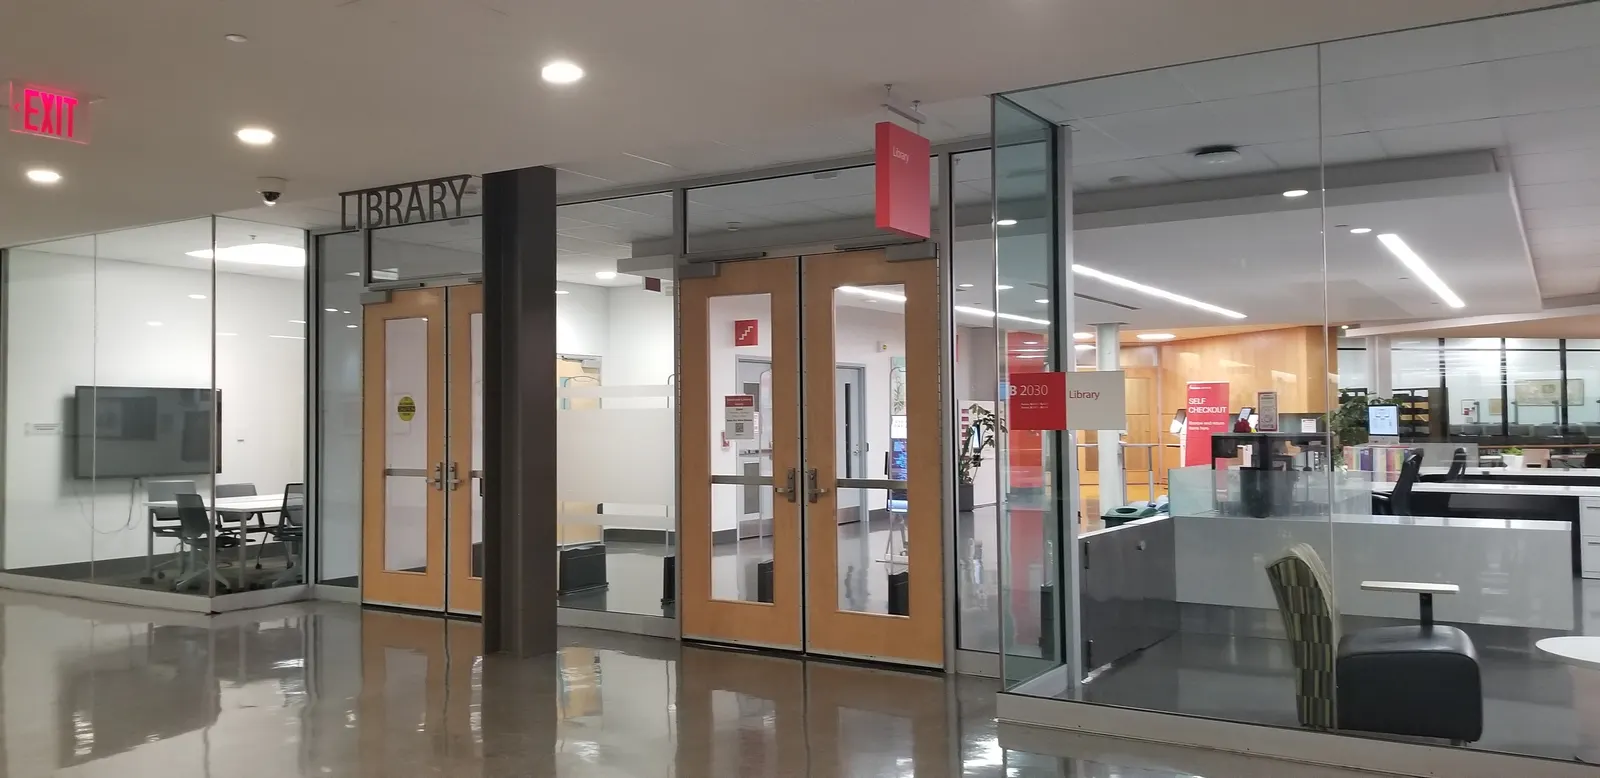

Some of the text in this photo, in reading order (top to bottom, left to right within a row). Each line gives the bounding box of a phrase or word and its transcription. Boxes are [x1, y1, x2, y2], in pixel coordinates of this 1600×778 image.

[24, 88, 78, 138] EXIT
[892, 145, 909, 165] Library
[340, 175, 471, 231] LIBRARY
[1020, 384, 1049, 396] 2030
[1069, 390, 1100, 401] Library
[1188, 397, 1207, 405] SELF
[1188, 406, 1227, 414] CHECKOUT
